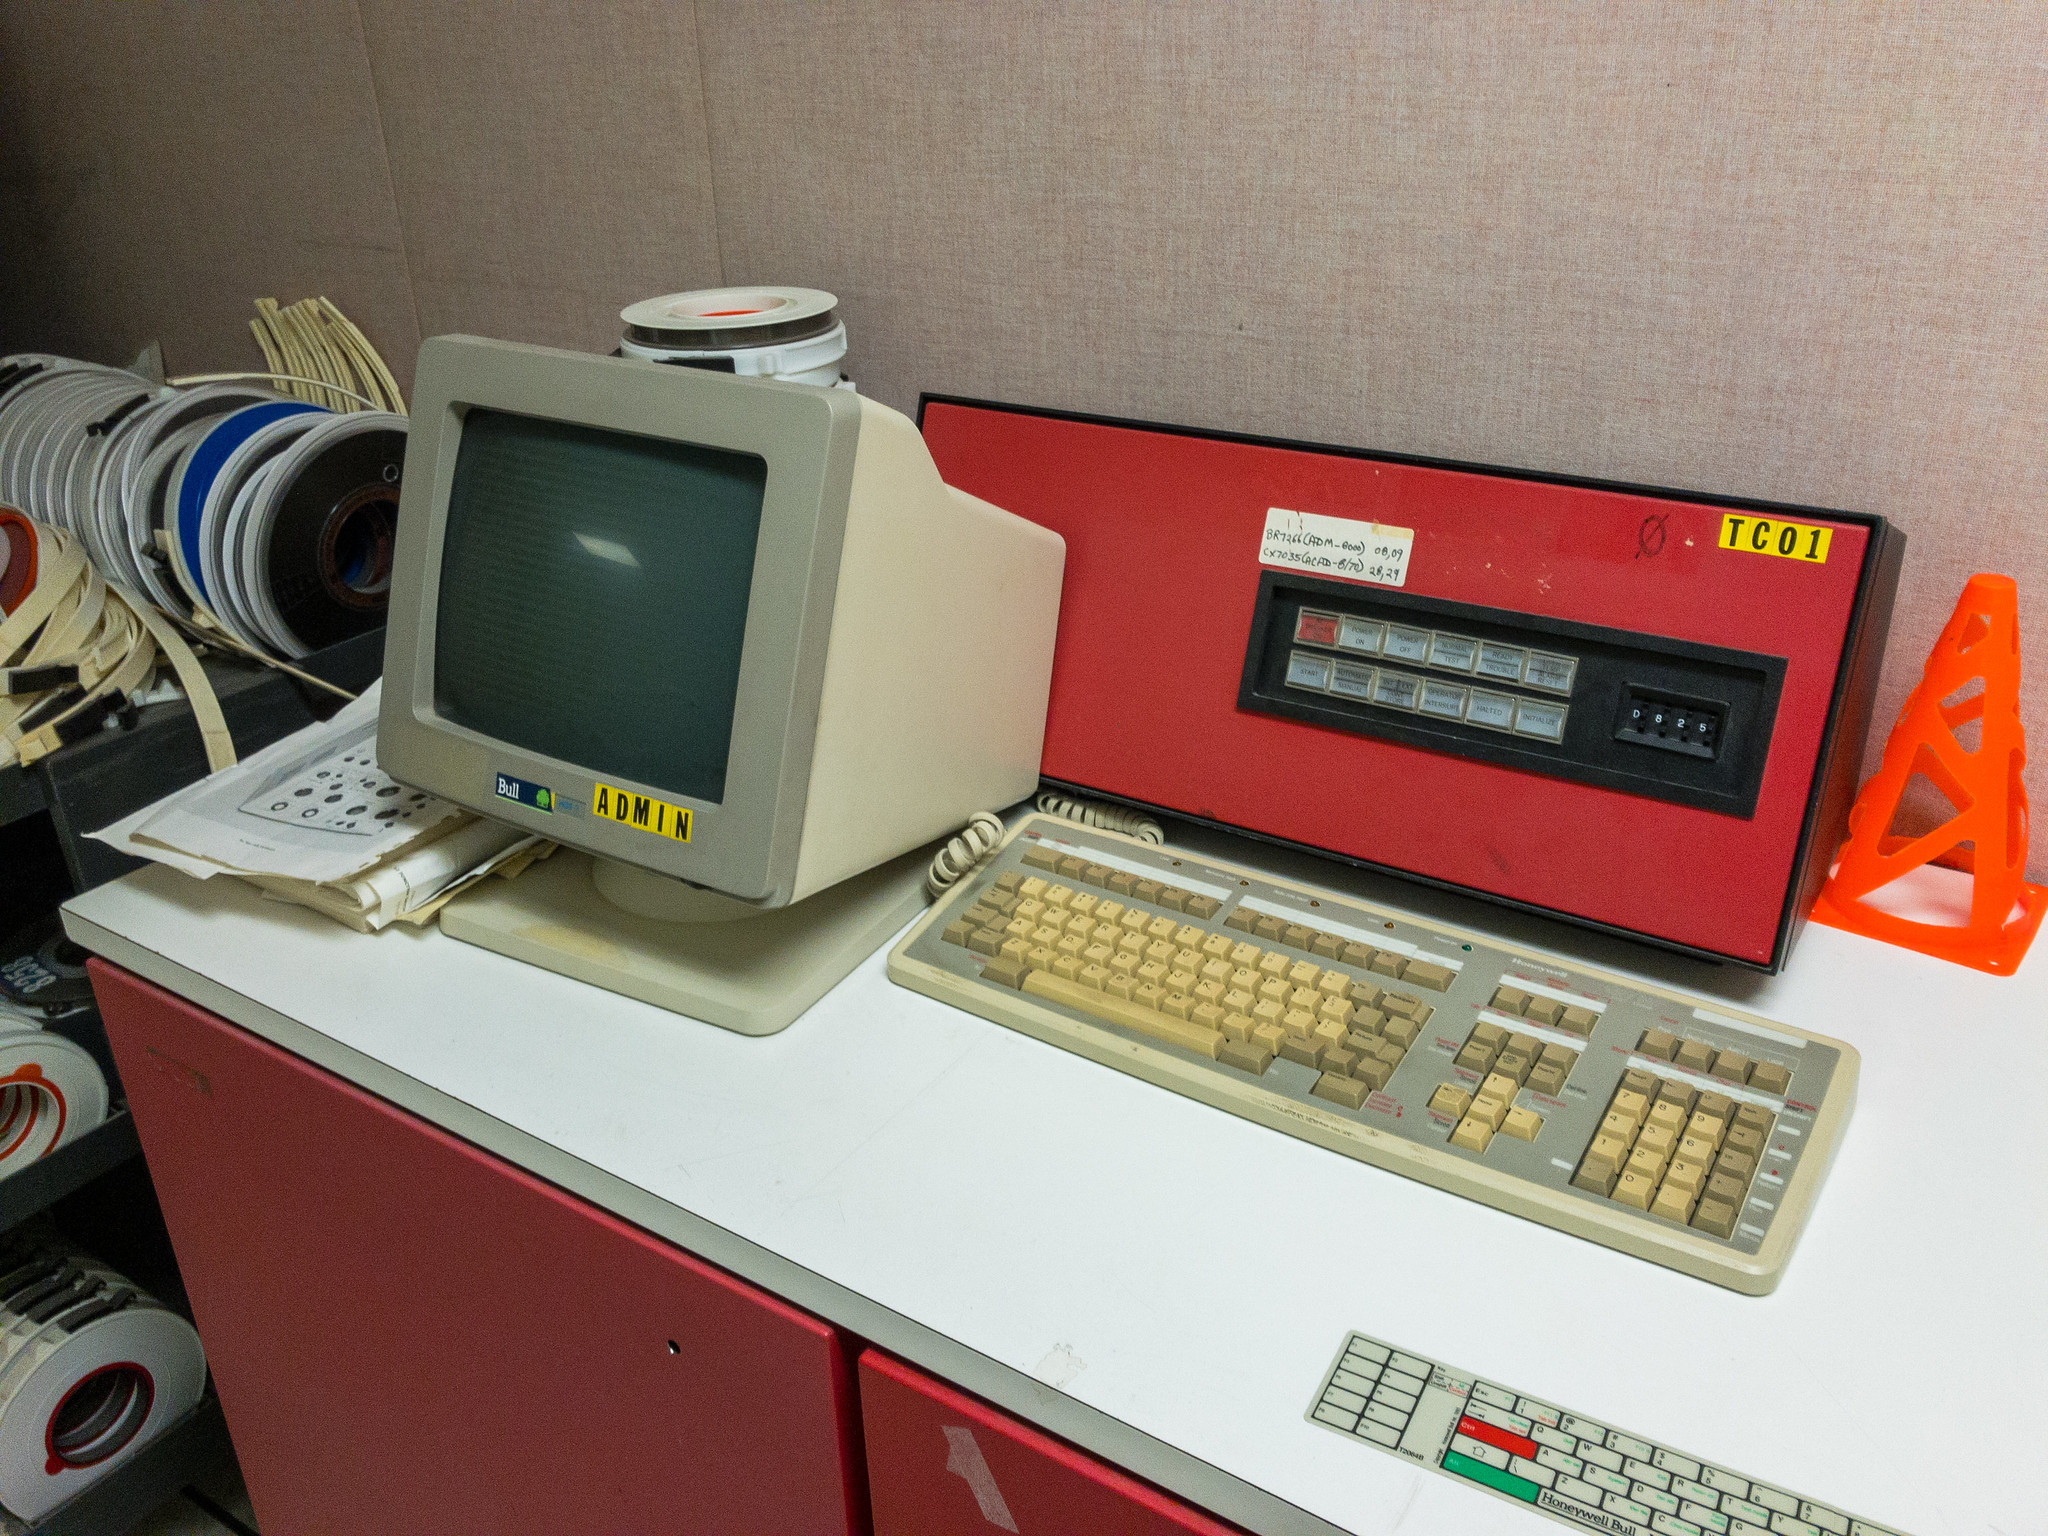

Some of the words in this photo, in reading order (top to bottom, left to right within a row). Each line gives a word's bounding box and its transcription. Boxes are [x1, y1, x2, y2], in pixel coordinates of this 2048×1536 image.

[1728, 517, 1822, 560] TC01
[1355, 638, 1365, 646] ON
[1445, 656, 1460, 664] TEST
[1300, 668, 1319, 677] START
[1485, 663, 1515, 676] TROUBLE
[1476, 705, 1503, 715] HALTED
[1655, 713, 1663, 723] 8
[1677, 718, 1686, 728] 2
[1699, 722, 1707, 732] 5
[497, 777, 520, 800] Bull
[596, 787, 690, 841] ADMIN
[1537, 1426, 1545, 1434] Q
[1583, 1443, 1592, 1451] W
[1589, 1467, 1596, 1475] S
[1677, 1479, 1685, 1487] R
[1637, 1485, 1644, 1493] D
[1609, 1495, 1616, 1503] X
[1685, 1503, 1692, 1511] F
[1542, 1491, 1610, 1527] Honeywell
[1612, 1519, 1637, 1536] Bull
[1658, 1515, 1666, 1523] C
[1735, 1522, 1743, 1531] G
